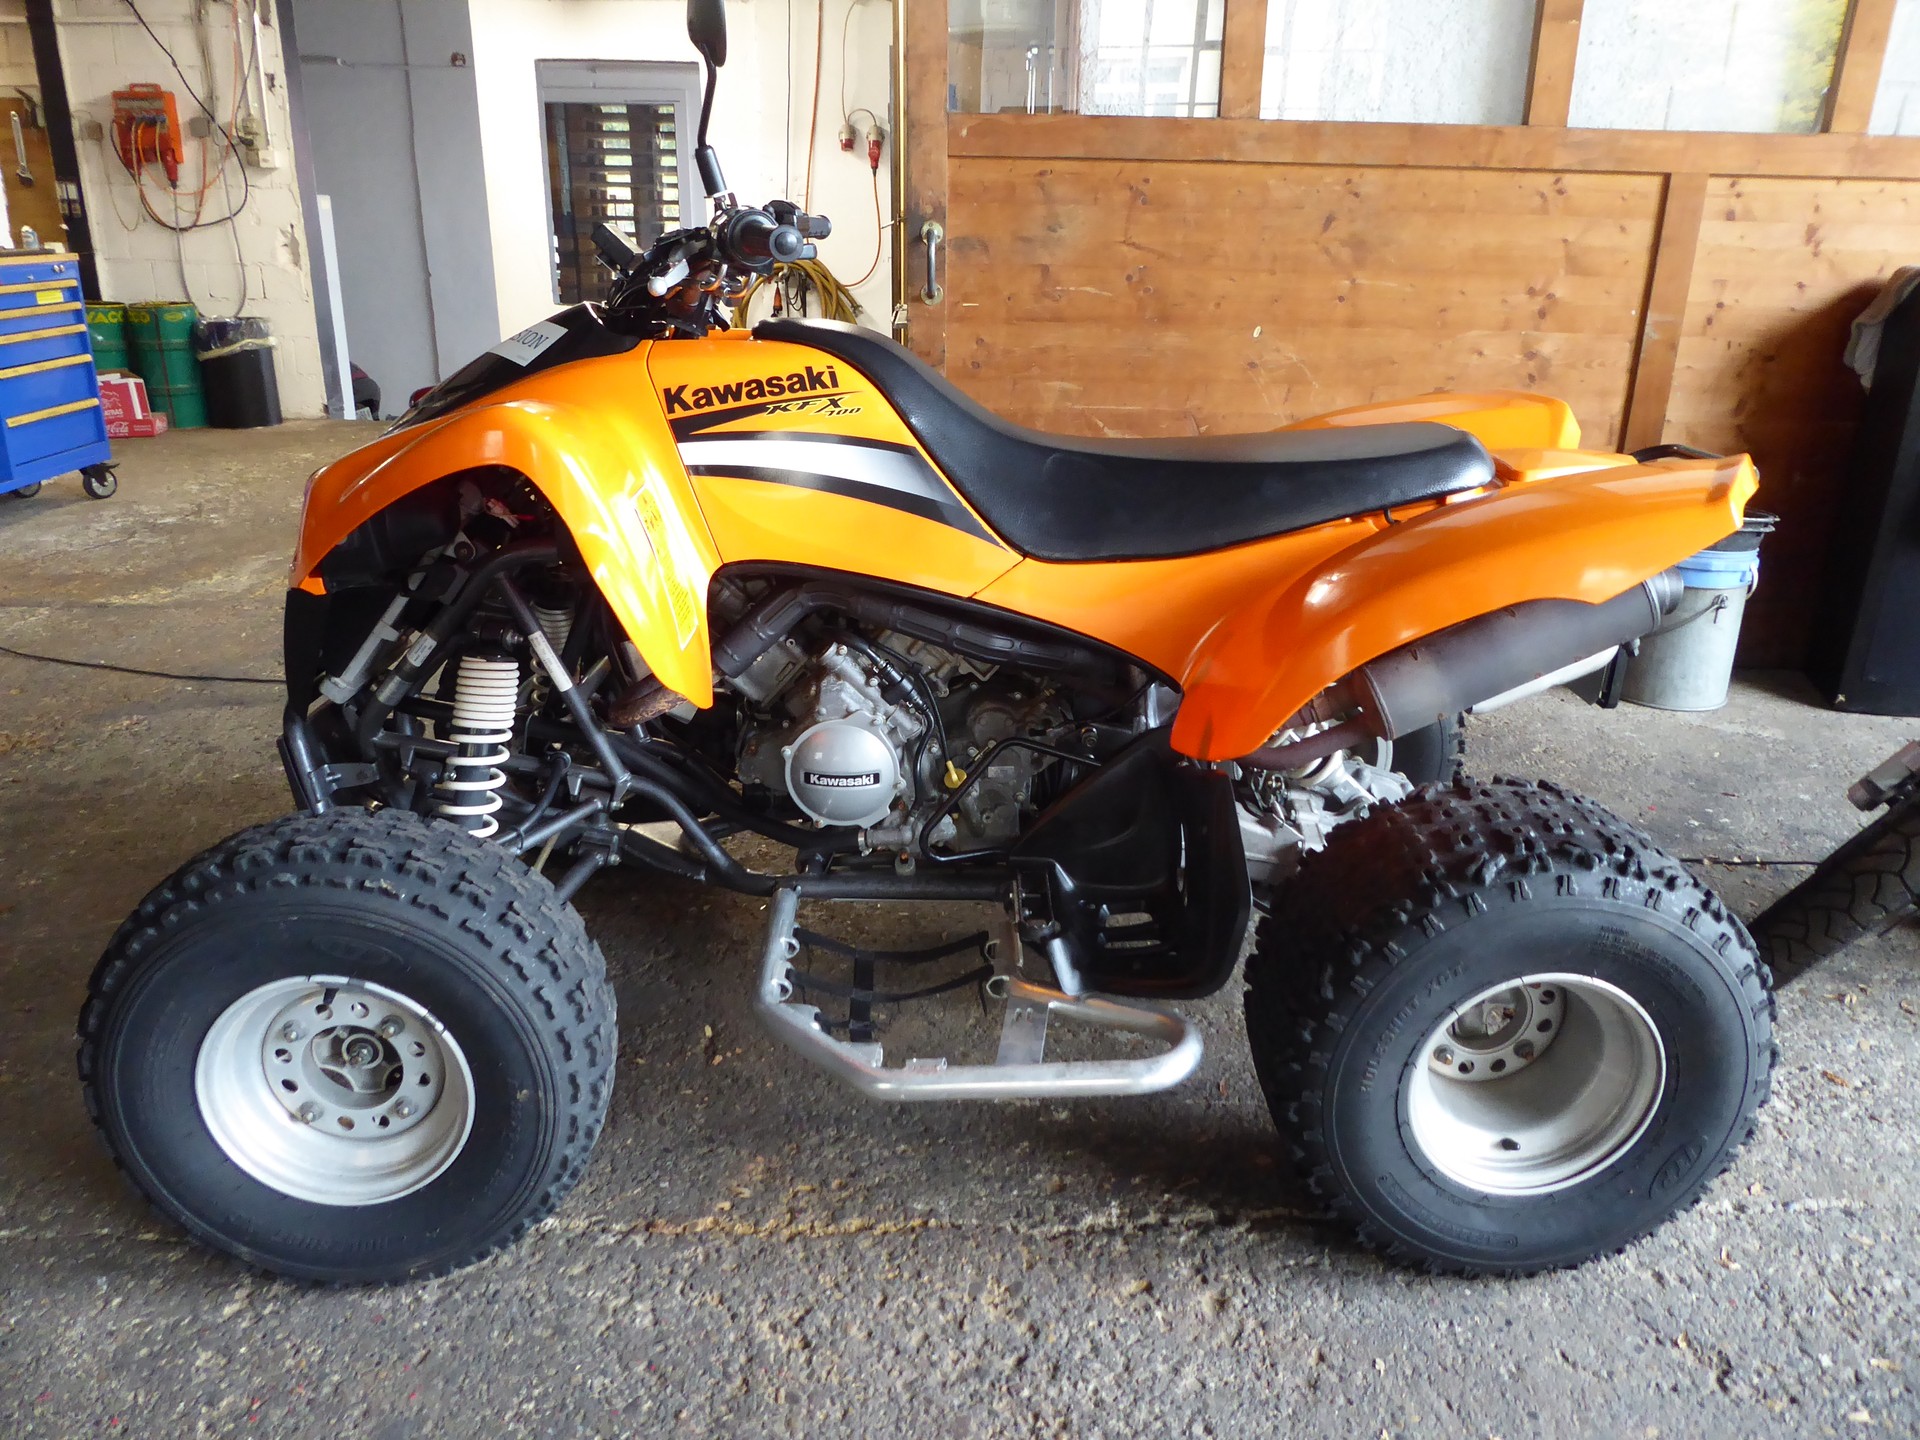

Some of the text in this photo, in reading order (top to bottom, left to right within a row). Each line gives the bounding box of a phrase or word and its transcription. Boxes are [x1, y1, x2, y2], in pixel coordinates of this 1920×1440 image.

[663, 365, 840, 415] Kawasaki
[765, 397, 845, 415] KFX
[810, 773, 875, 786] Kawasaki
